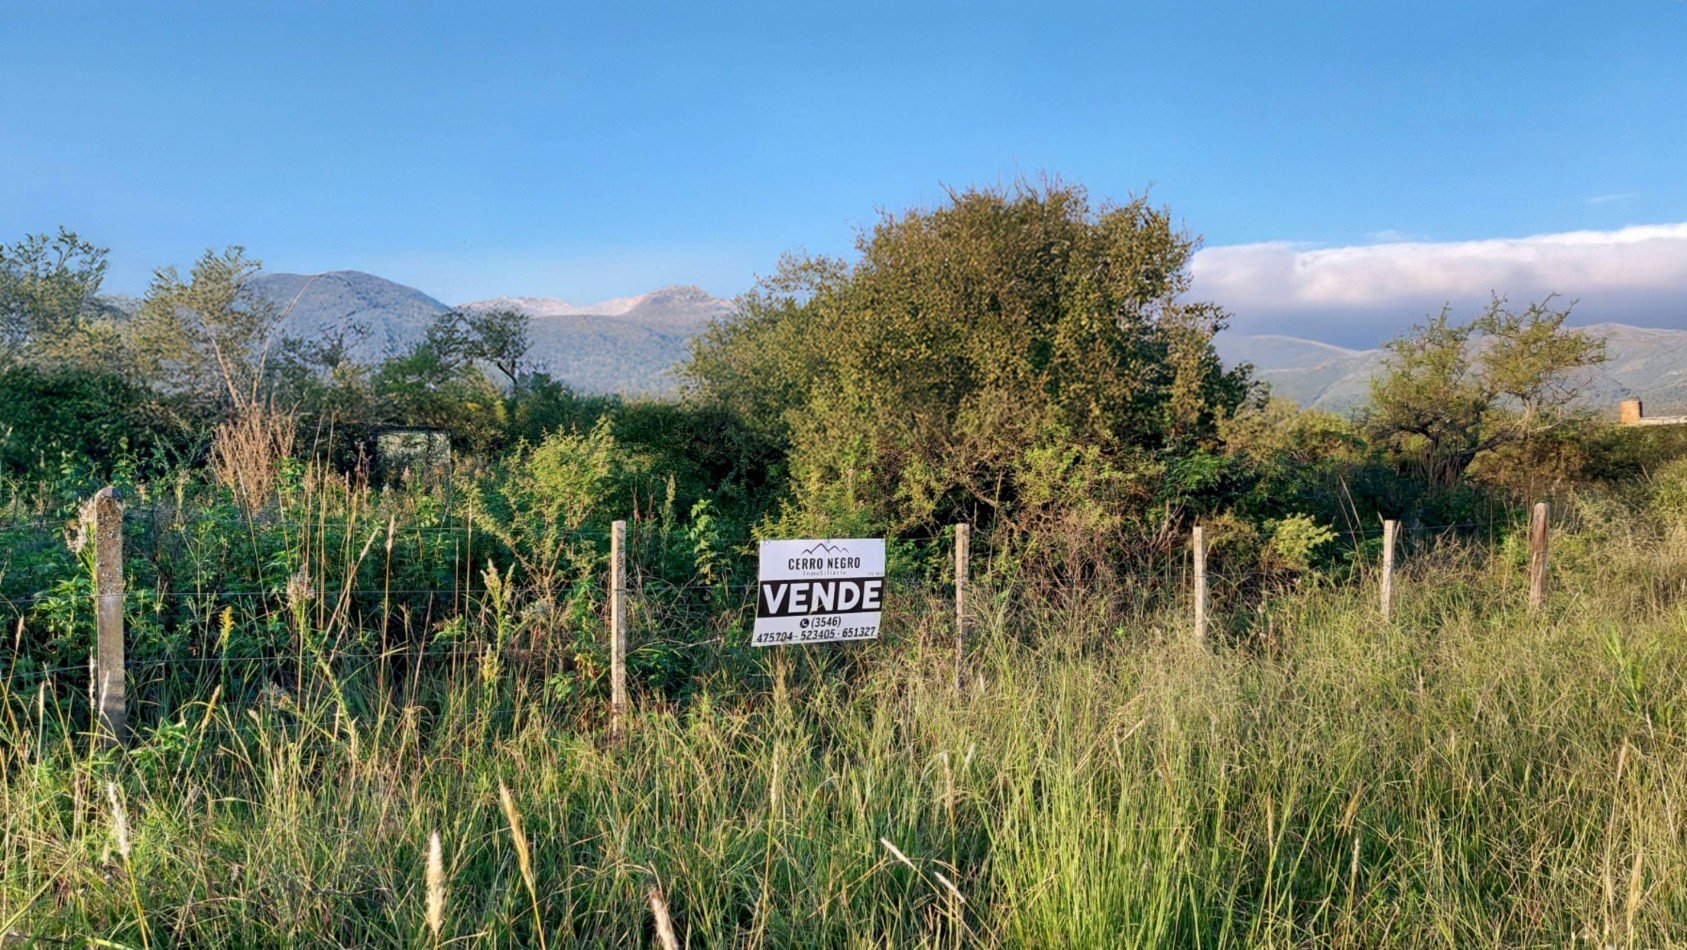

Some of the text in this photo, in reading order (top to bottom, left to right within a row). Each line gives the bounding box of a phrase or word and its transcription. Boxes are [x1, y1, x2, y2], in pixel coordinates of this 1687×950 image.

[788, 557, 861, 570] CERRO NEGRO
[763, 581, 882, 614] VENDE
[811, 616, 841, 629] (3546)
[800, 629, 835, 641] 523405
[842, 626, 876, 638] 651327
